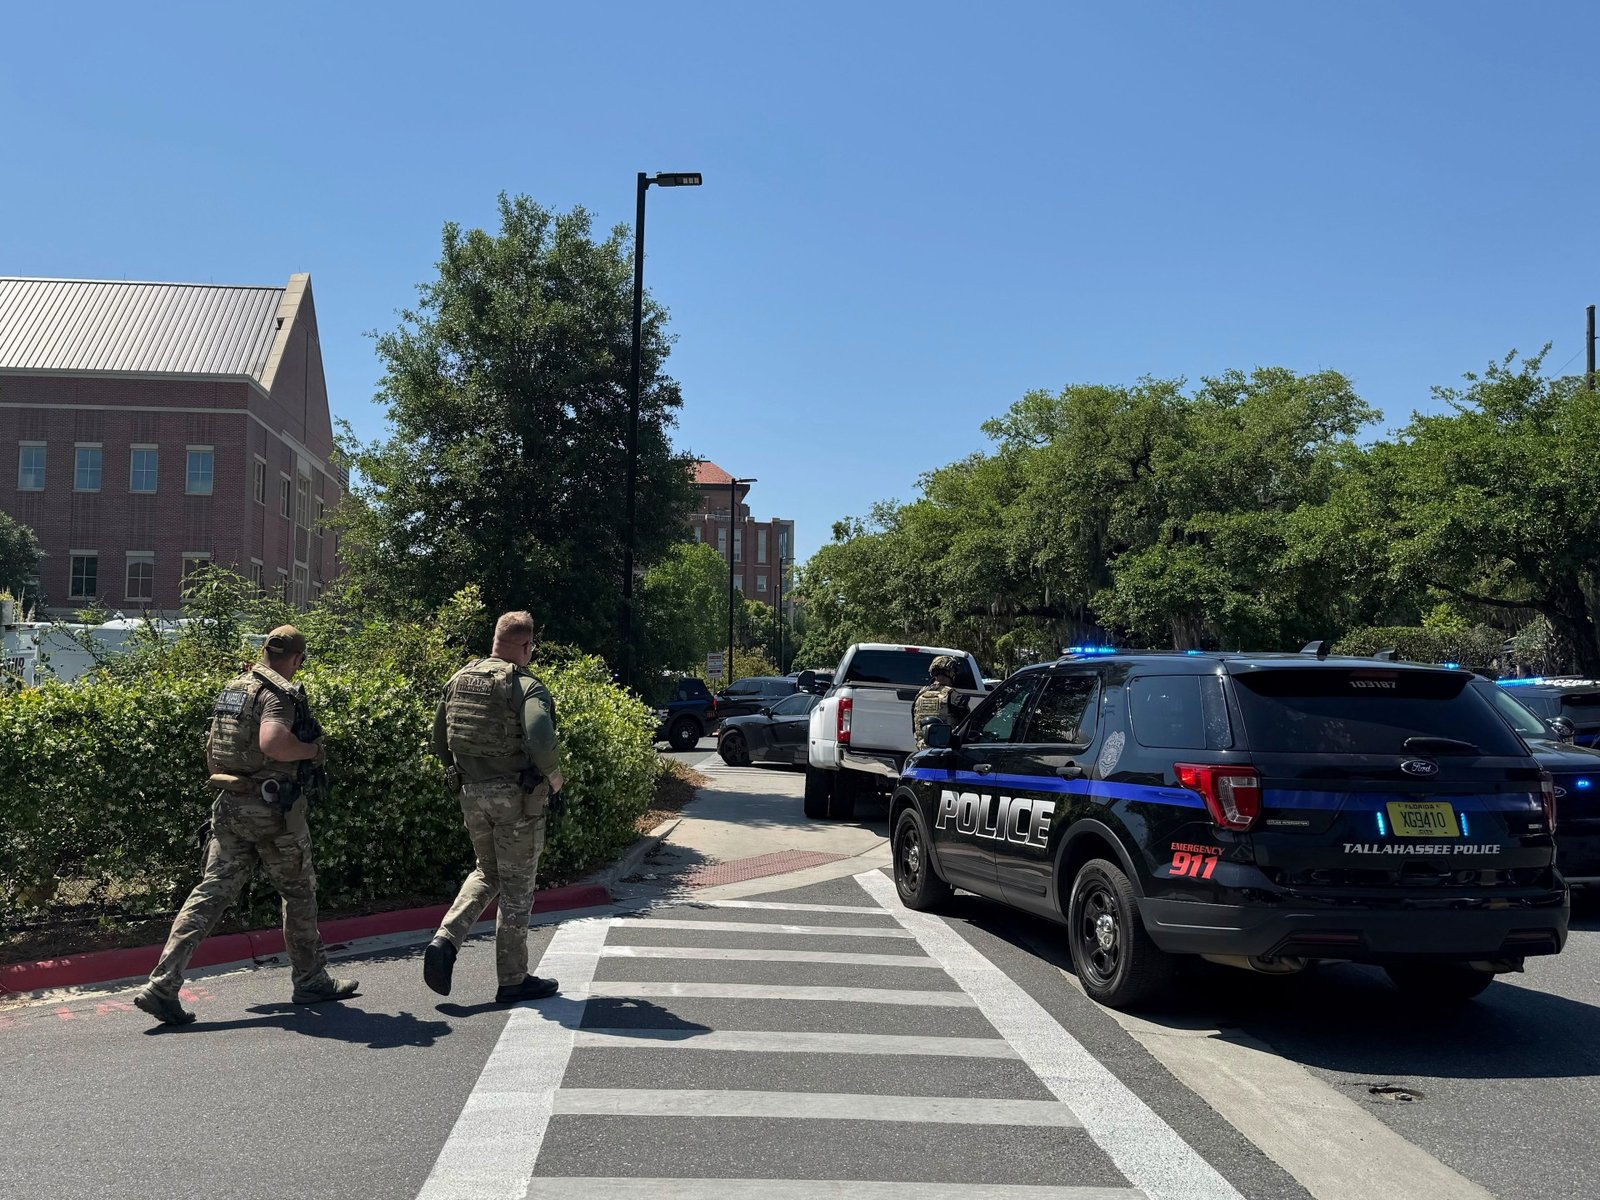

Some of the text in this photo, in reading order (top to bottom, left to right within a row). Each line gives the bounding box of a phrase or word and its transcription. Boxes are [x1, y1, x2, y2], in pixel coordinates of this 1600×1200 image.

[1349, 680, 1397, 689] 103187
[935, 789, 1056, 848] POLICE
[1400, 811, 1446, 828] XG9410
[1170, 842, 1225, 856] EMERGENCY
[1342, 843, 1501, 855] TALLAHASSEE POLICE
[1169, 851, 1218, 880] 911
